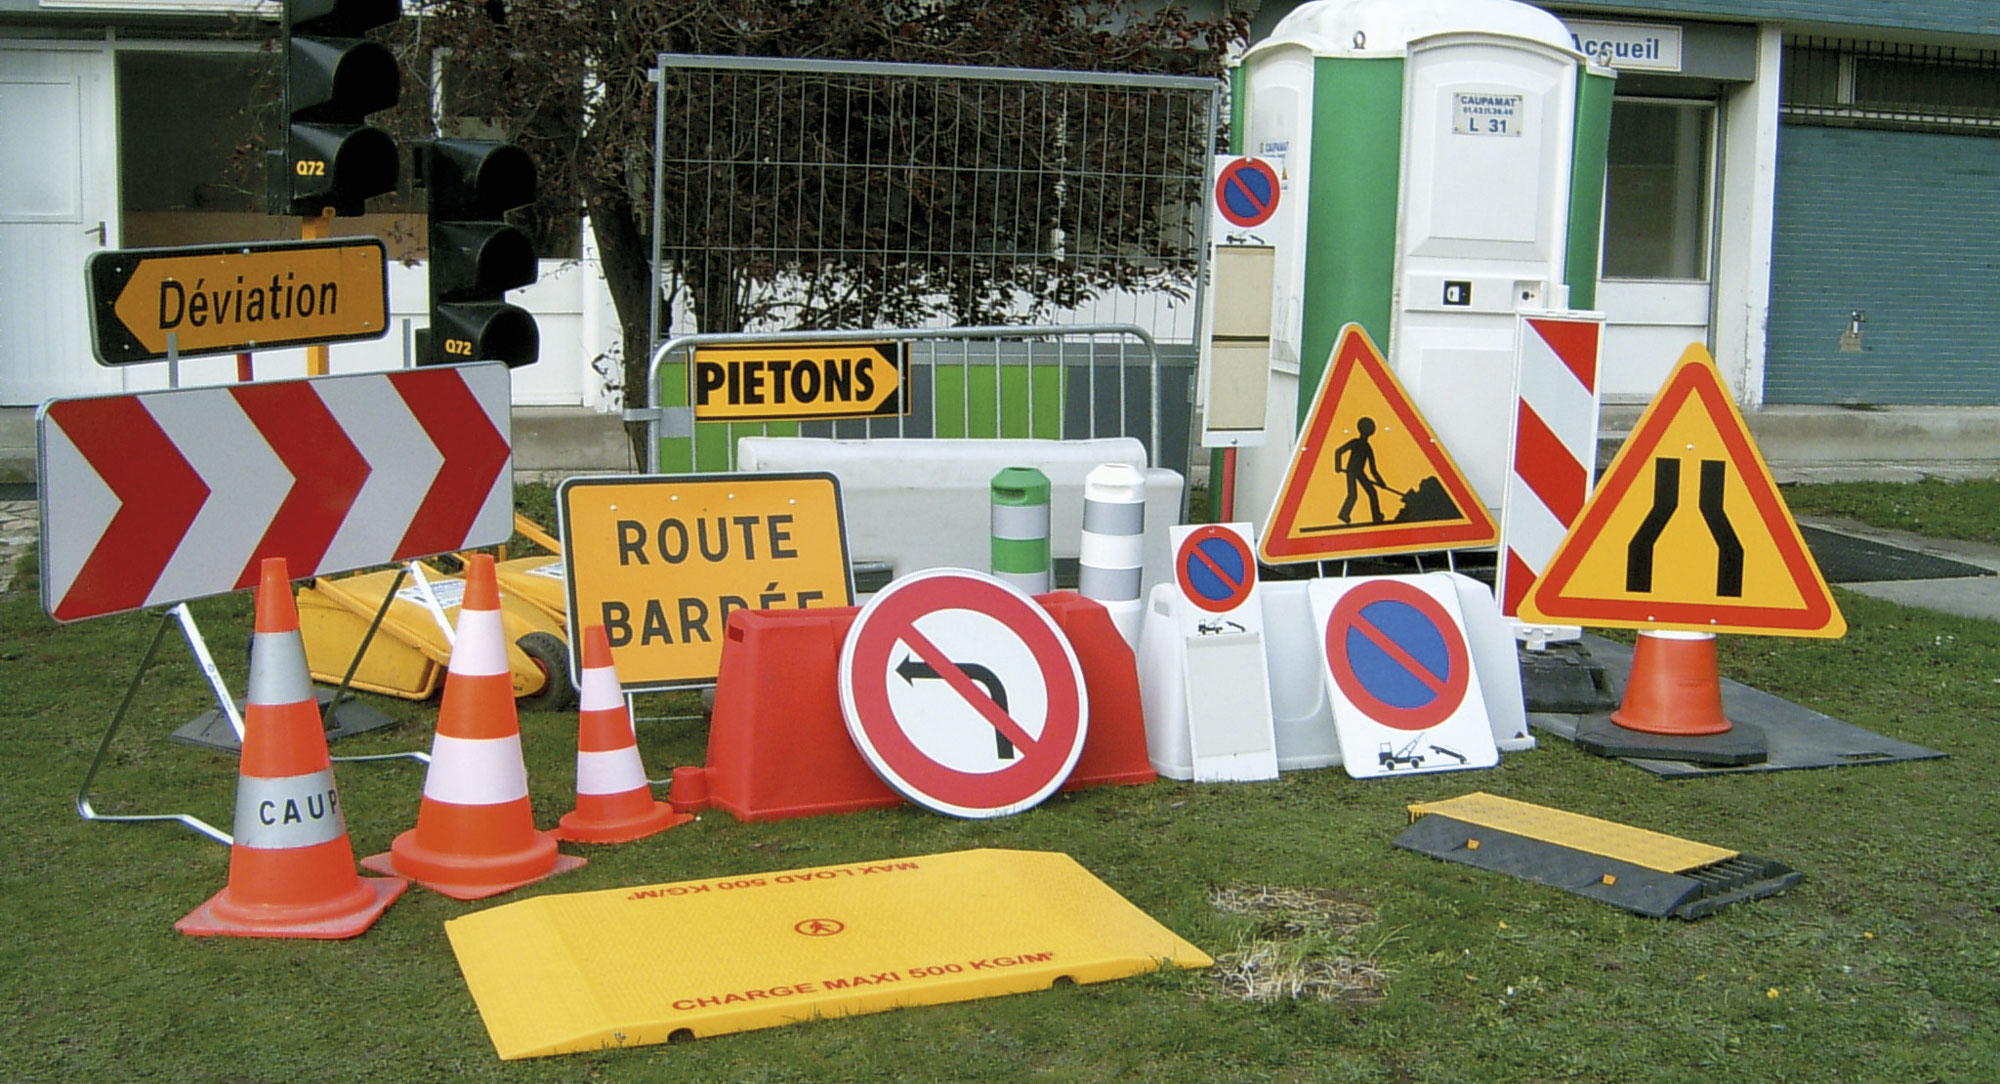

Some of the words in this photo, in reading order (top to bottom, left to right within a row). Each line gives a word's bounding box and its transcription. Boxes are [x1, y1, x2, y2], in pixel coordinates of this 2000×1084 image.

[1460, 95, 1517, 107] CAUPAMAT
[1469, 117, 1479, 132] L
[1488, 118, 1507, 133] 31
[296, 160, 325, 176] Q72
[159, 272, 338, 330] Déviation
[445, 338, 472, 356] Q72
[696, 357, 875, 406] PIETONS
[617, 514, 798, 566] ROUTE
[260, 788, 338, 826] CAUP
[775, 868, 854, 884] LOAD
[860, 861, 920, 876] MAX
[717, 878, 767, 890] 500
[671, 981, 817, 1012] CHARGE
[822, 970, 902, 991] MAXI
[908, 962, 964, 979] 500
